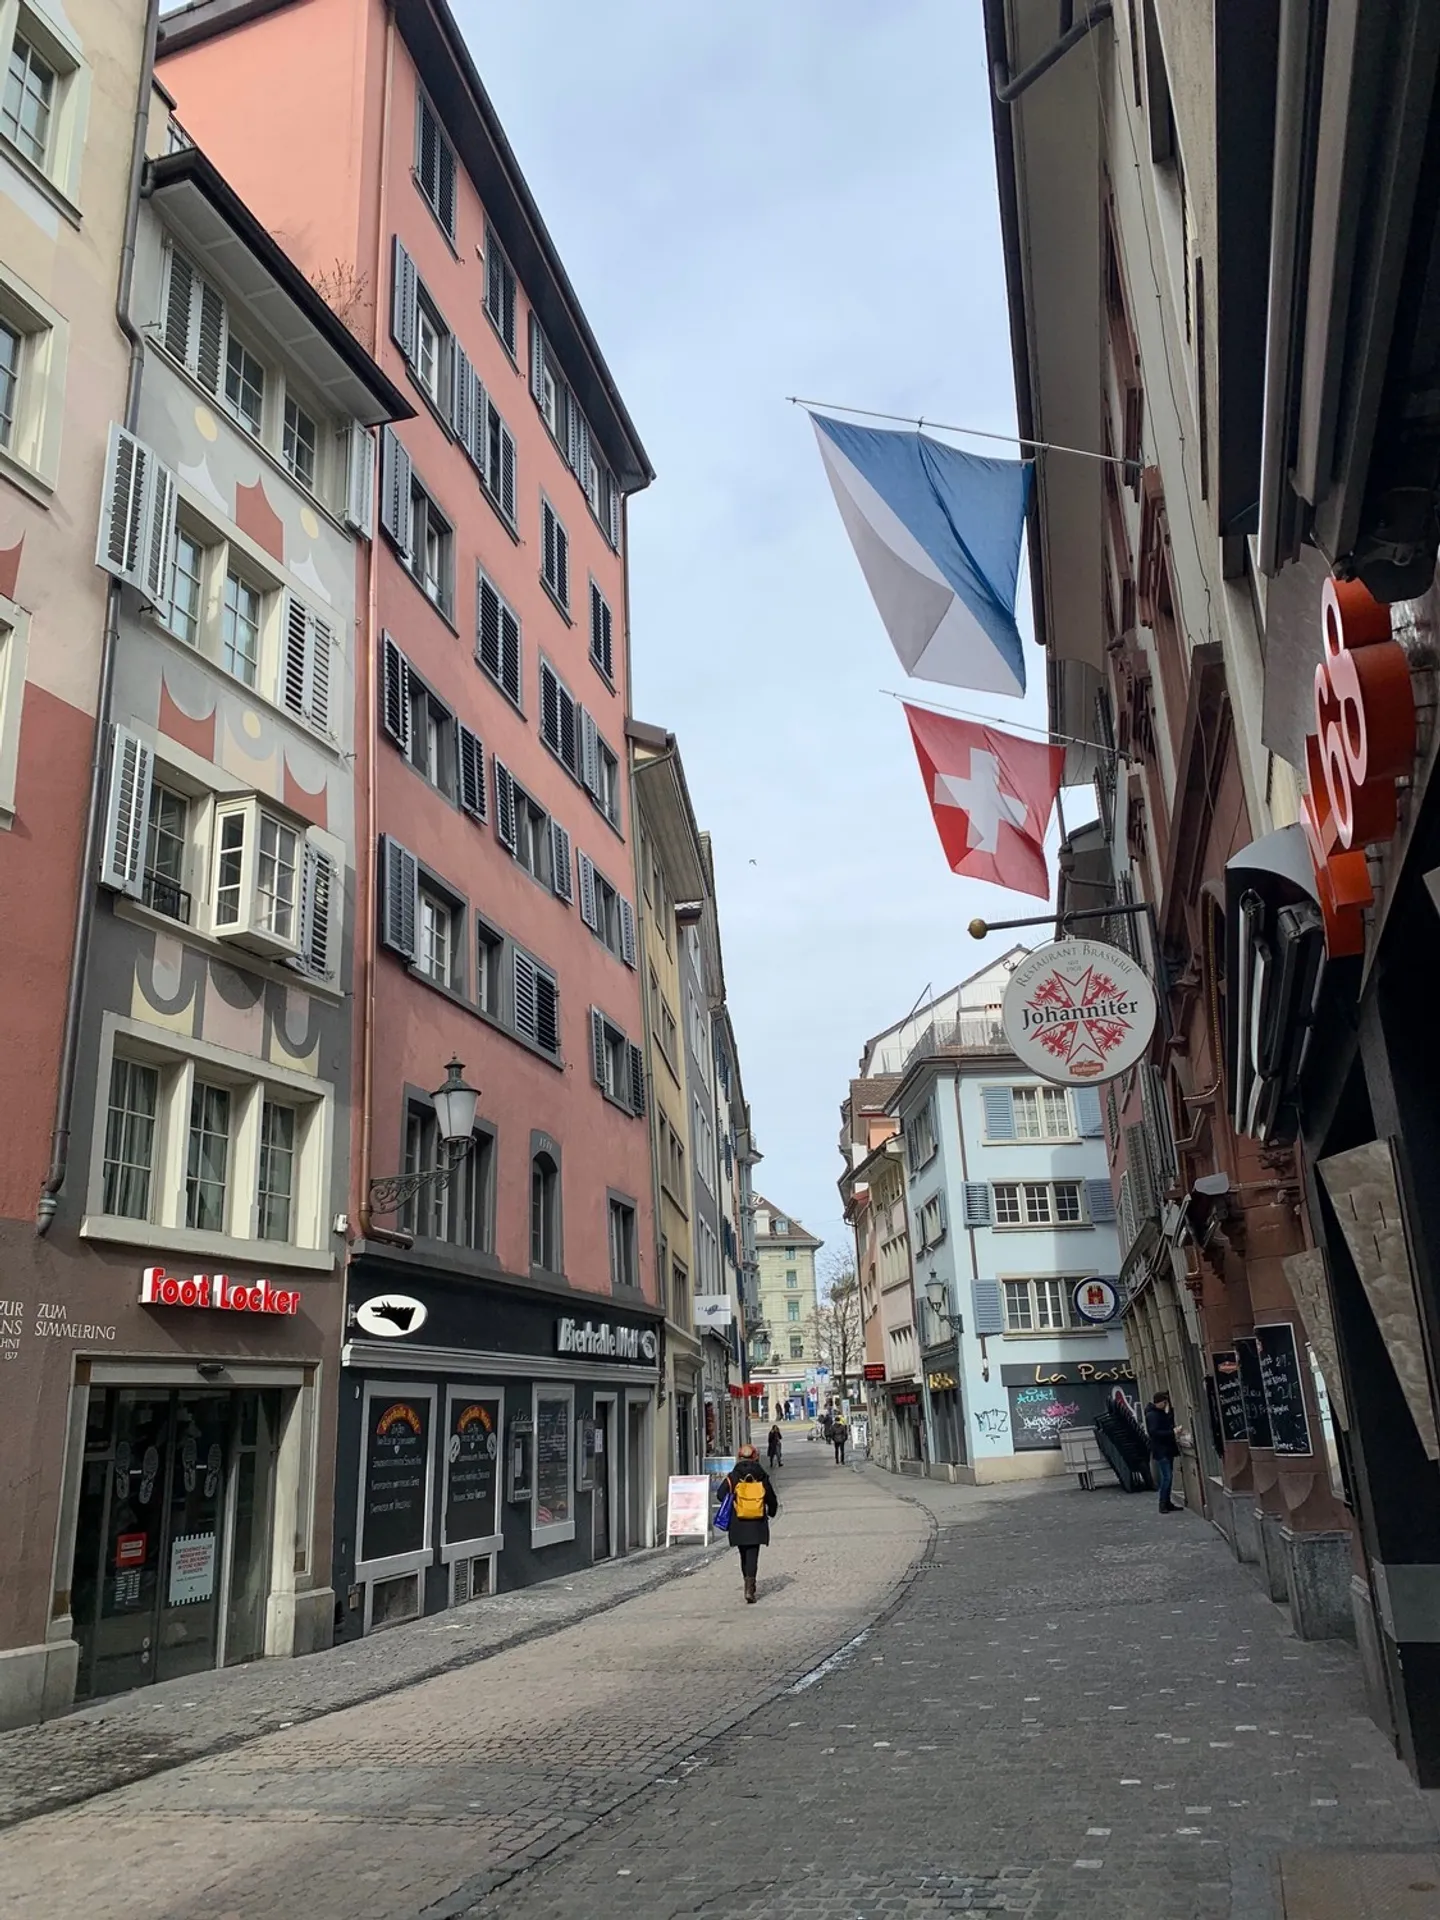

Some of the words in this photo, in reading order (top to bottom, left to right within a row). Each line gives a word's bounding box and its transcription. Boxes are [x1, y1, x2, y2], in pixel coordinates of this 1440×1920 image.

[1015, 946, 1077, 987] RESTAURANT
[1082, 943, 1134, 974] BRASSERIE
[1021, 999, 1138, 1031] Johanniter
[145, 1267, 209, 1307] Foot
[213, 1274, 301, 1315] Locker
[37, 1303, 67, 1319] ZUM
[0, 1320, 22, 1335] NS
[34, 1320, 116, 1340] SIMMELRING
[557, 1317, 616, 1356] Bierhalle
[1035, 1365, 1067, 1384] La
[1077, 1363, 1136, 1381] Past
